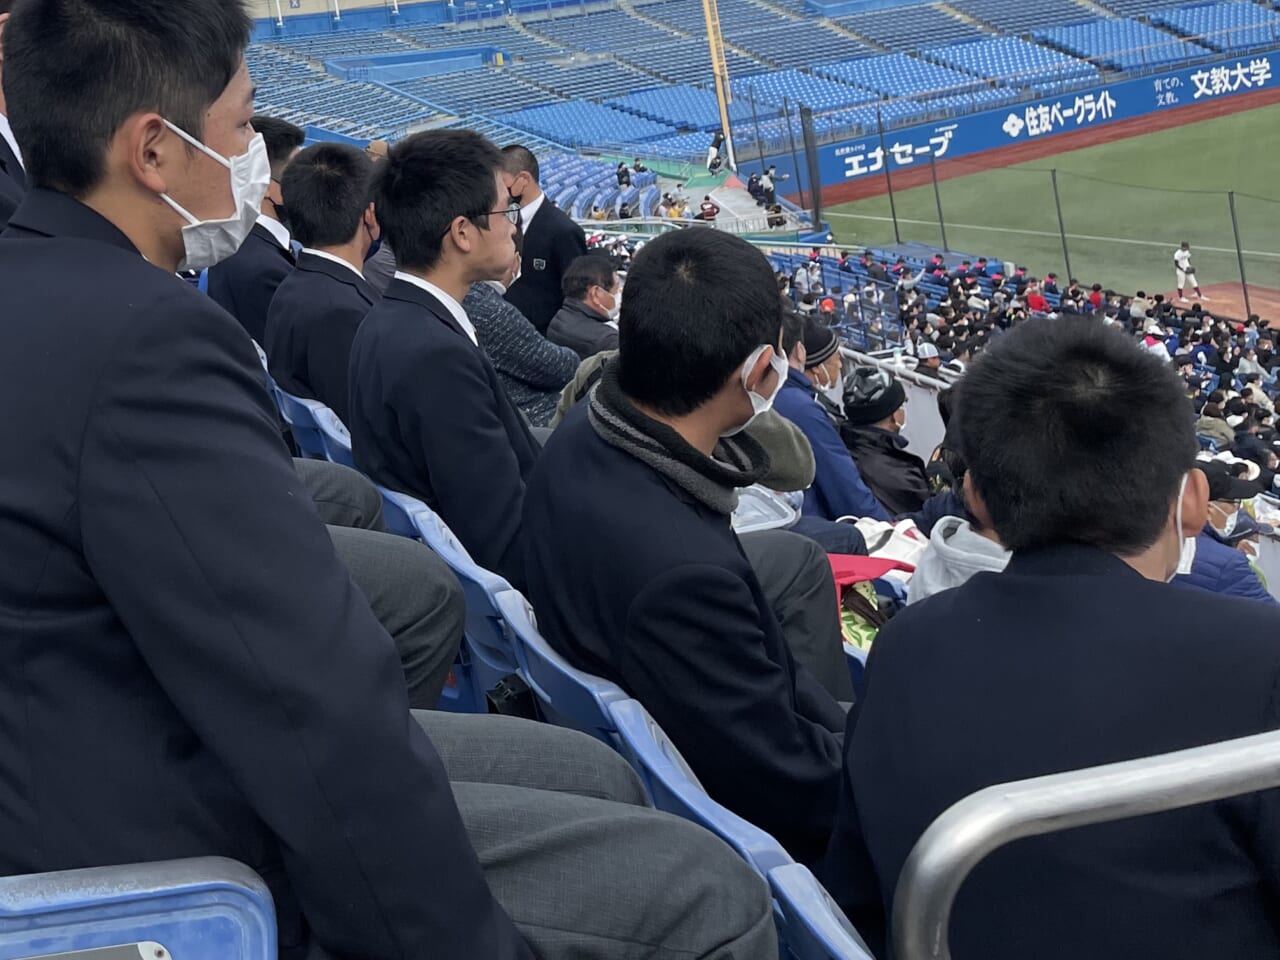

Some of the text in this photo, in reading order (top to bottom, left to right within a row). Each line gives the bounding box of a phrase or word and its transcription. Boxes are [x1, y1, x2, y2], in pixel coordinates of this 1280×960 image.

[1190, 57, 1273, 100] 文教大学
[1025, 90, 1117, 137] 住友ベークライト
[844, 130, 953, 178] エナセーブ
